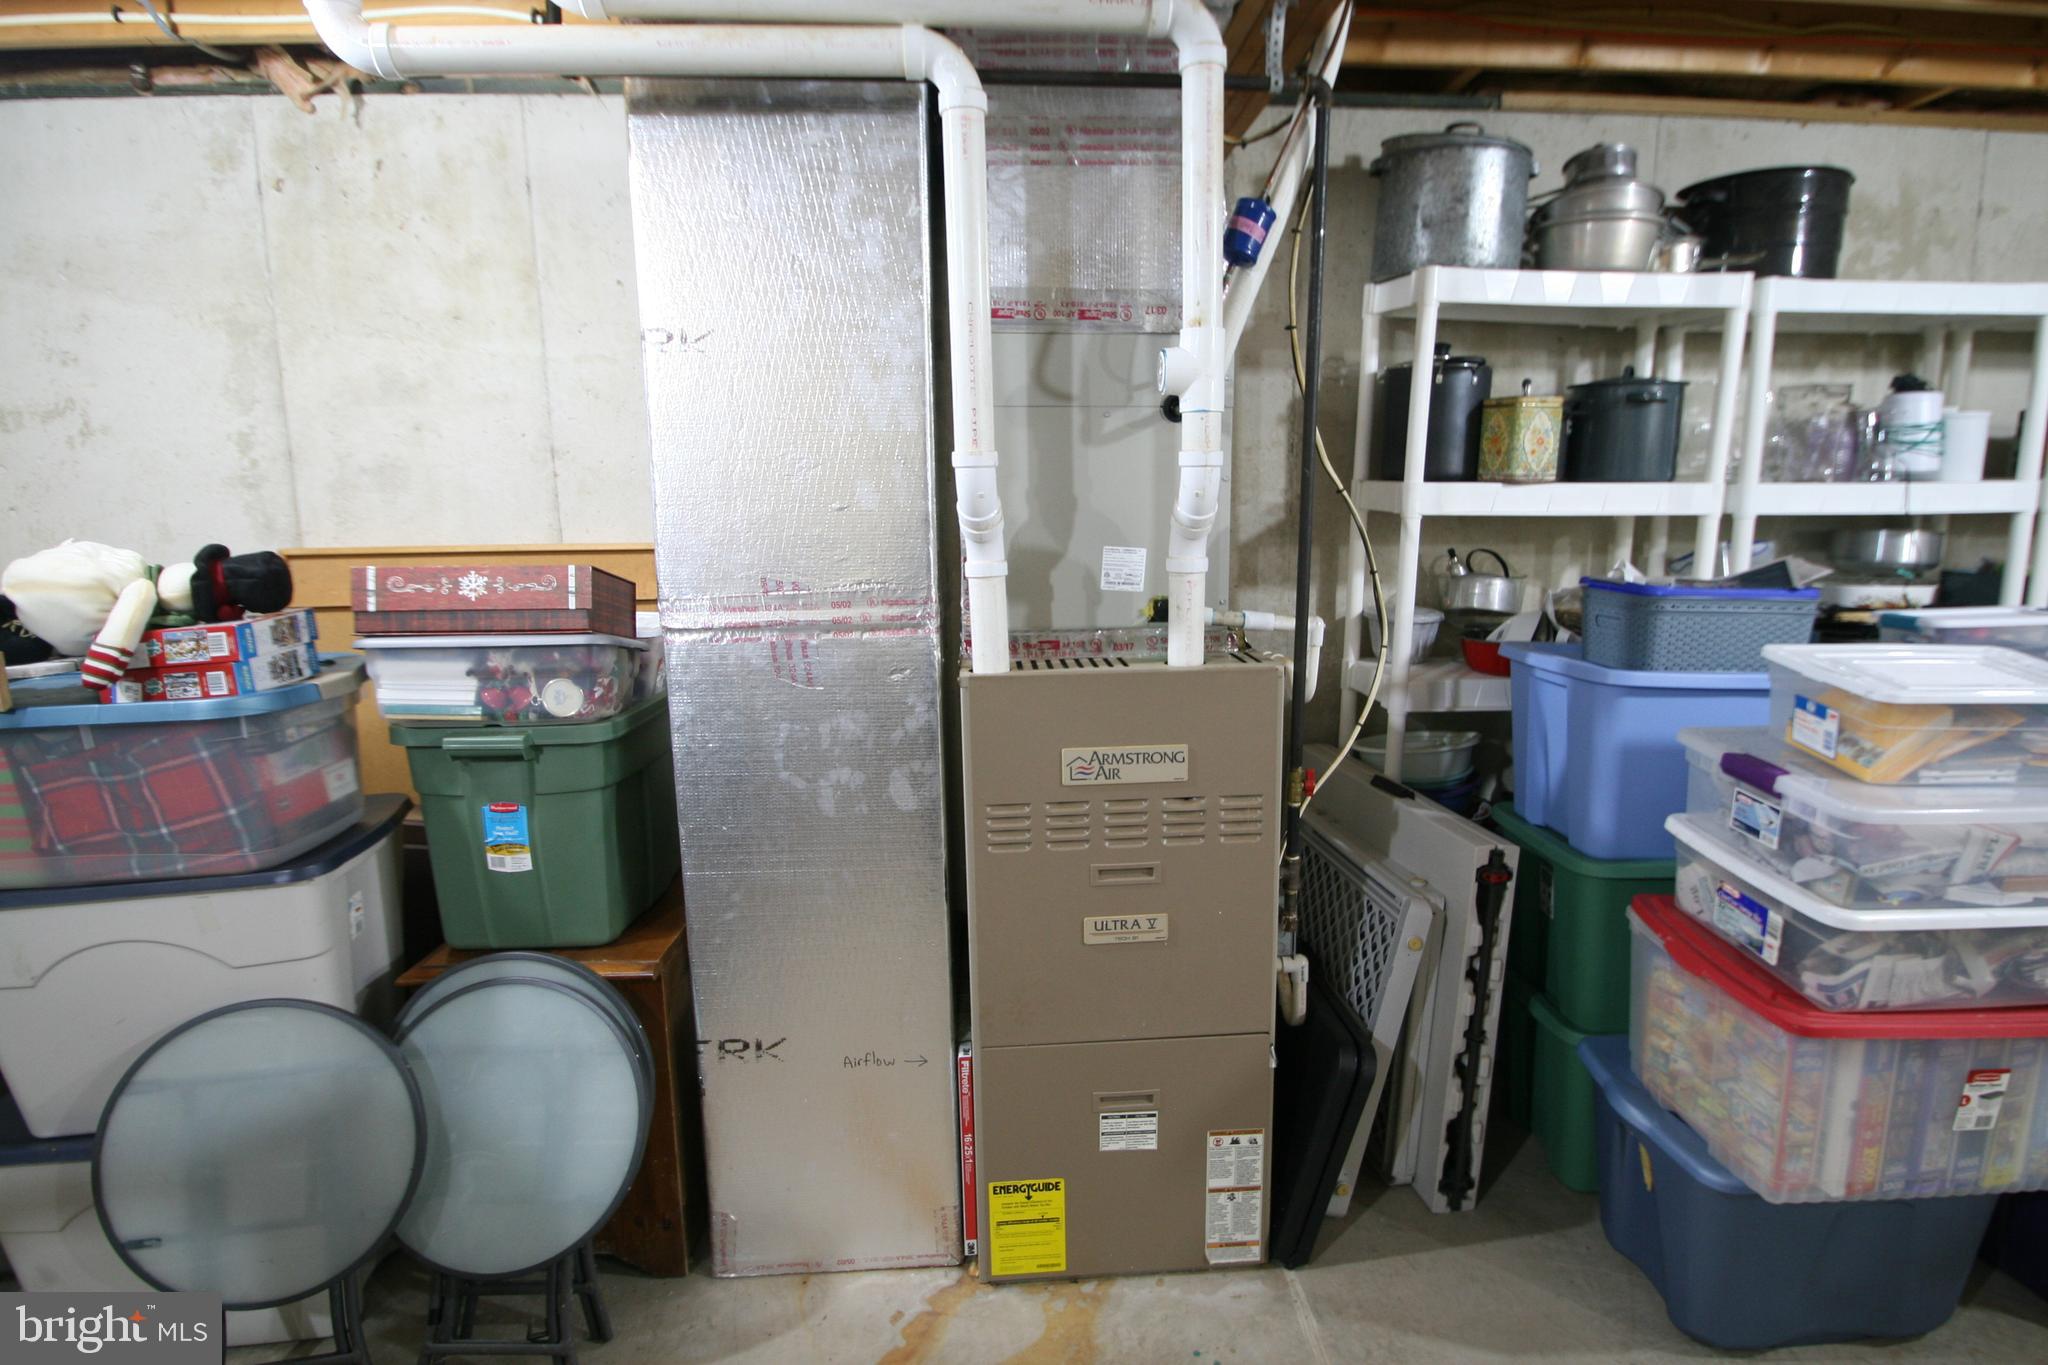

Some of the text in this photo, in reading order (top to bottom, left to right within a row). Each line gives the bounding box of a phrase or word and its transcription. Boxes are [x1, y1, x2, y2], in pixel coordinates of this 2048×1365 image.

[970, 407, 979, 449] PIPE
[830, 600, 852, 609] 05/02
[1088, 750, 1185, 766] ARMSTRONG
[1094, 765, 1122, 781] AIR
[1094, 918, 1158, 932] ULTRA V
[843, 1051, 896, 1068] Airflow
[960, 1060, 970, 1094] Filtrete
[992, 1181, 1062, 1196] ENERGYGUIDE
[966, 1241, 976, 1255] 3M
